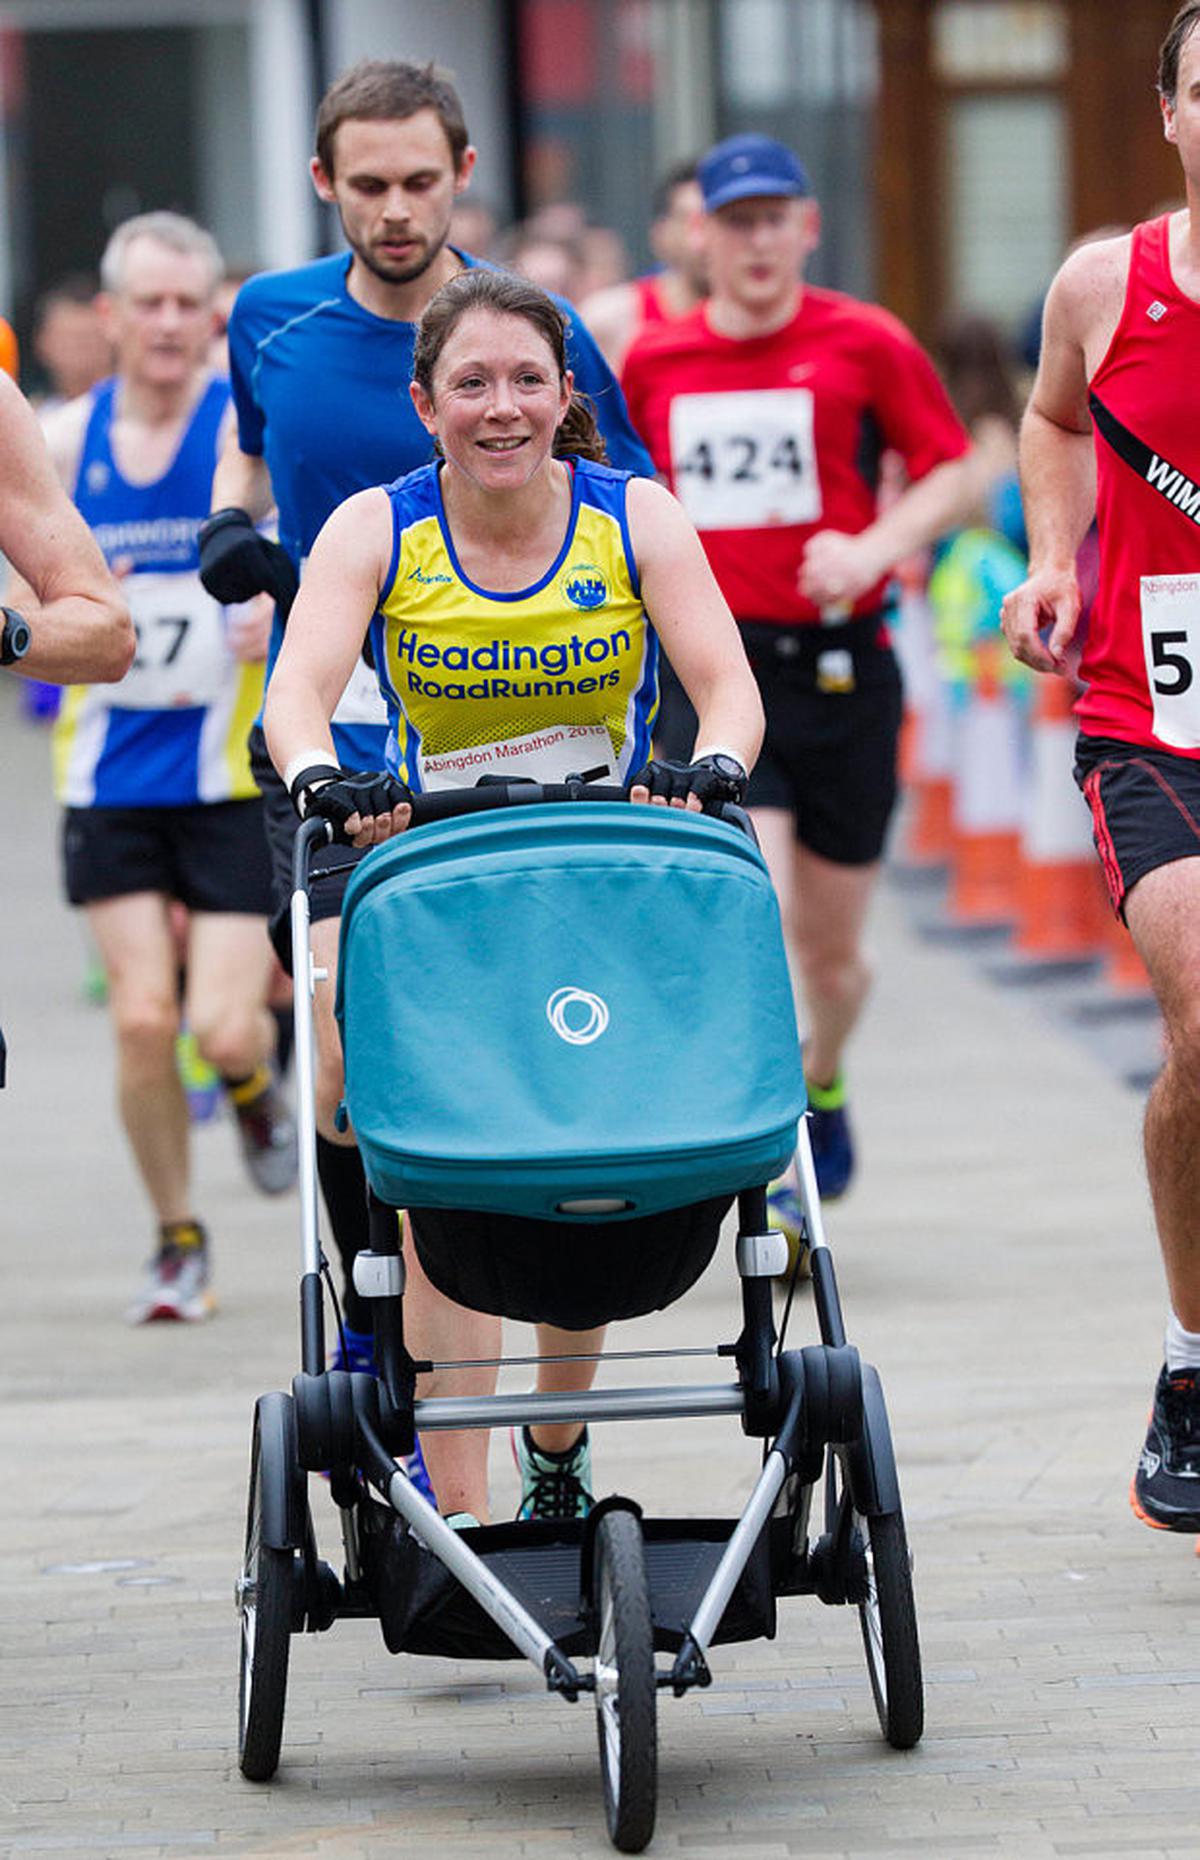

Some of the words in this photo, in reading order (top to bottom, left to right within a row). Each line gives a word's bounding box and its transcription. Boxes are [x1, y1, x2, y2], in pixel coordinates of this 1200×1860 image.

[678, 436, 802, 481] 424
[1146, 453, 1200, 525] WIM
[398, 629, 630, 676] Headington
[1151, 630, 1193, 696] 5
[407, 669, 620, 699] RoadRunners
[424, 750, 493, 773] Abingdon
[495, 730, 565, 758] Marathon
